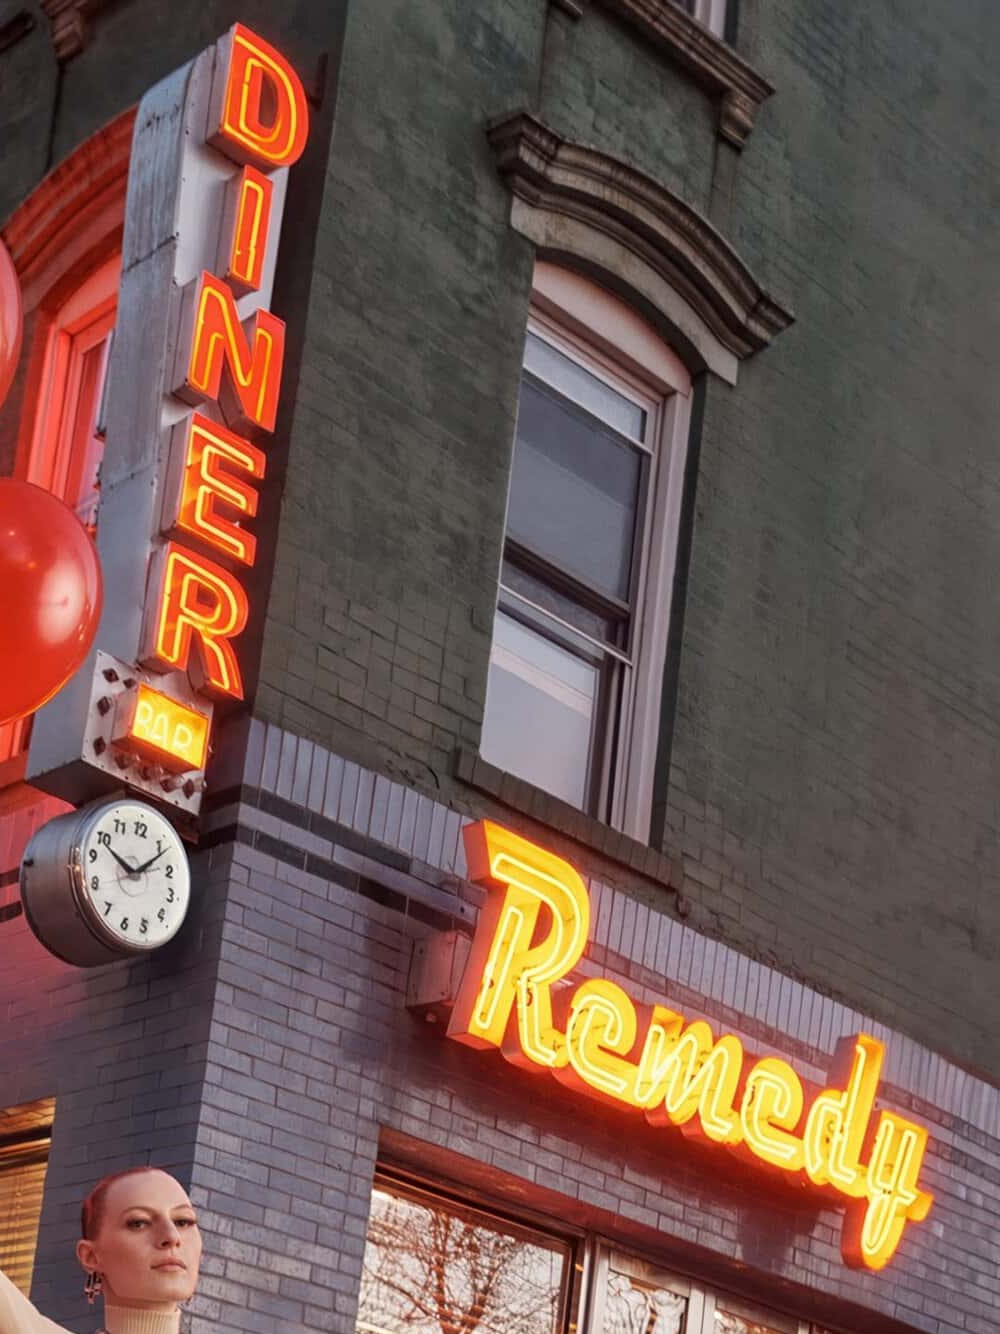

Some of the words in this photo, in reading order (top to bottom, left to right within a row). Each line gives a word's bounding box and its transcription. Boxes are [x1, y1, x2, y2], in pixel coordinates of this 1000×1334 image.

[153, 22, 309, 700] DINER
[113, 819, 126, 835] 11
[133, 821, 148, 839] 12
[96, 831, 111, 846] 10
[89, 849, 98, 863] 9
[165, 865, 174, 879] 2
[91, 876, 99, 891] 8
[166, 887, 175, 903] 3
[103, 901, 113, 916] 7
[120, 917, 129, 931] 6
[139, 918, 149, 934] 5
[464, 818, 934, 1272] Remedy
